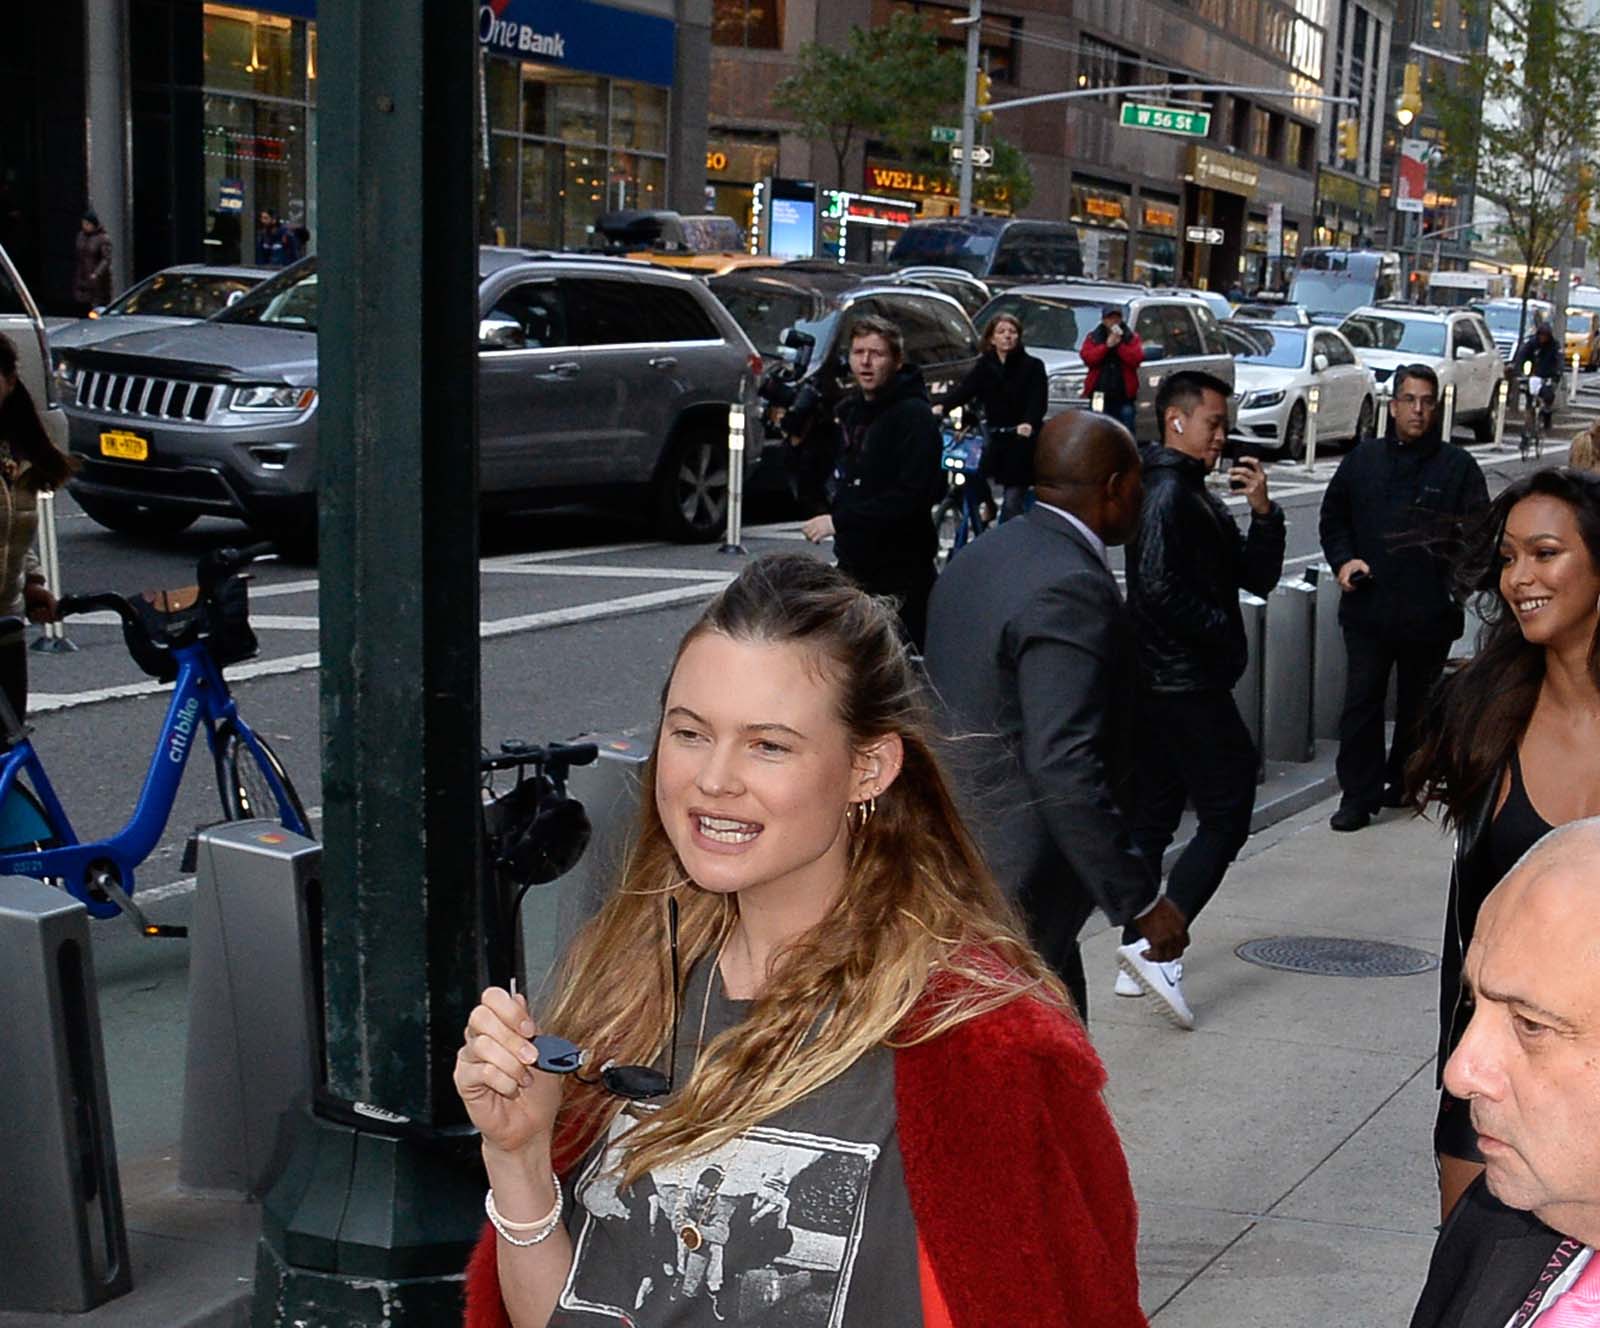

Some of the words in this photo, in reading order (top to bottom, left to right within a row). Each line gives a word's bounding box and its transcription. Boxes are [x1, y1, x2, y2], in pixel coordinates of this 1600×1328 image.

[479, 5, 518, 48] One
[518, 26, 566, 57] Bank
[1137, 110, 1150, 124] W
[1153, 112, 1172, 128] 56
[1175, 116, 1193, 131] St
